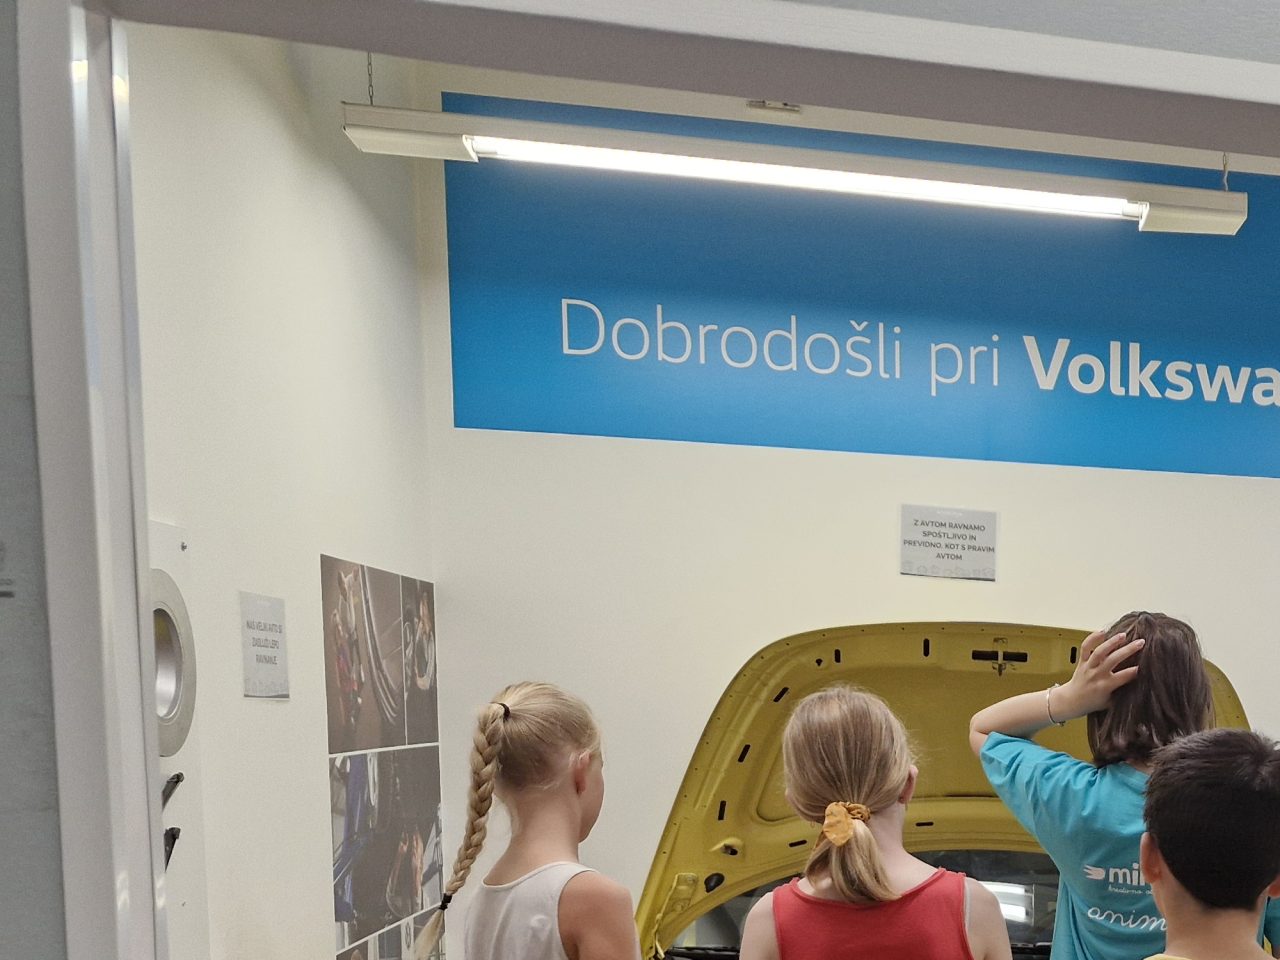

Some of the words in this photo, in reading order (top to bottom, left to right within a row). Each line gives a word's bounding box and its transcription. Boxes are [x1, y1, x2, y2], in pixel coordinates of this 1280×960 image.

[561, 298, 901, 379] Dobrodošli
[930, 334, 999, 396] pri
[920, 520, 947, 529] AVTOM
[948, 522, 986, 532] RAVNAMO
[967, 544, 995, 553] PRAVIM
[936, 552, 963, 560] AVTOM
